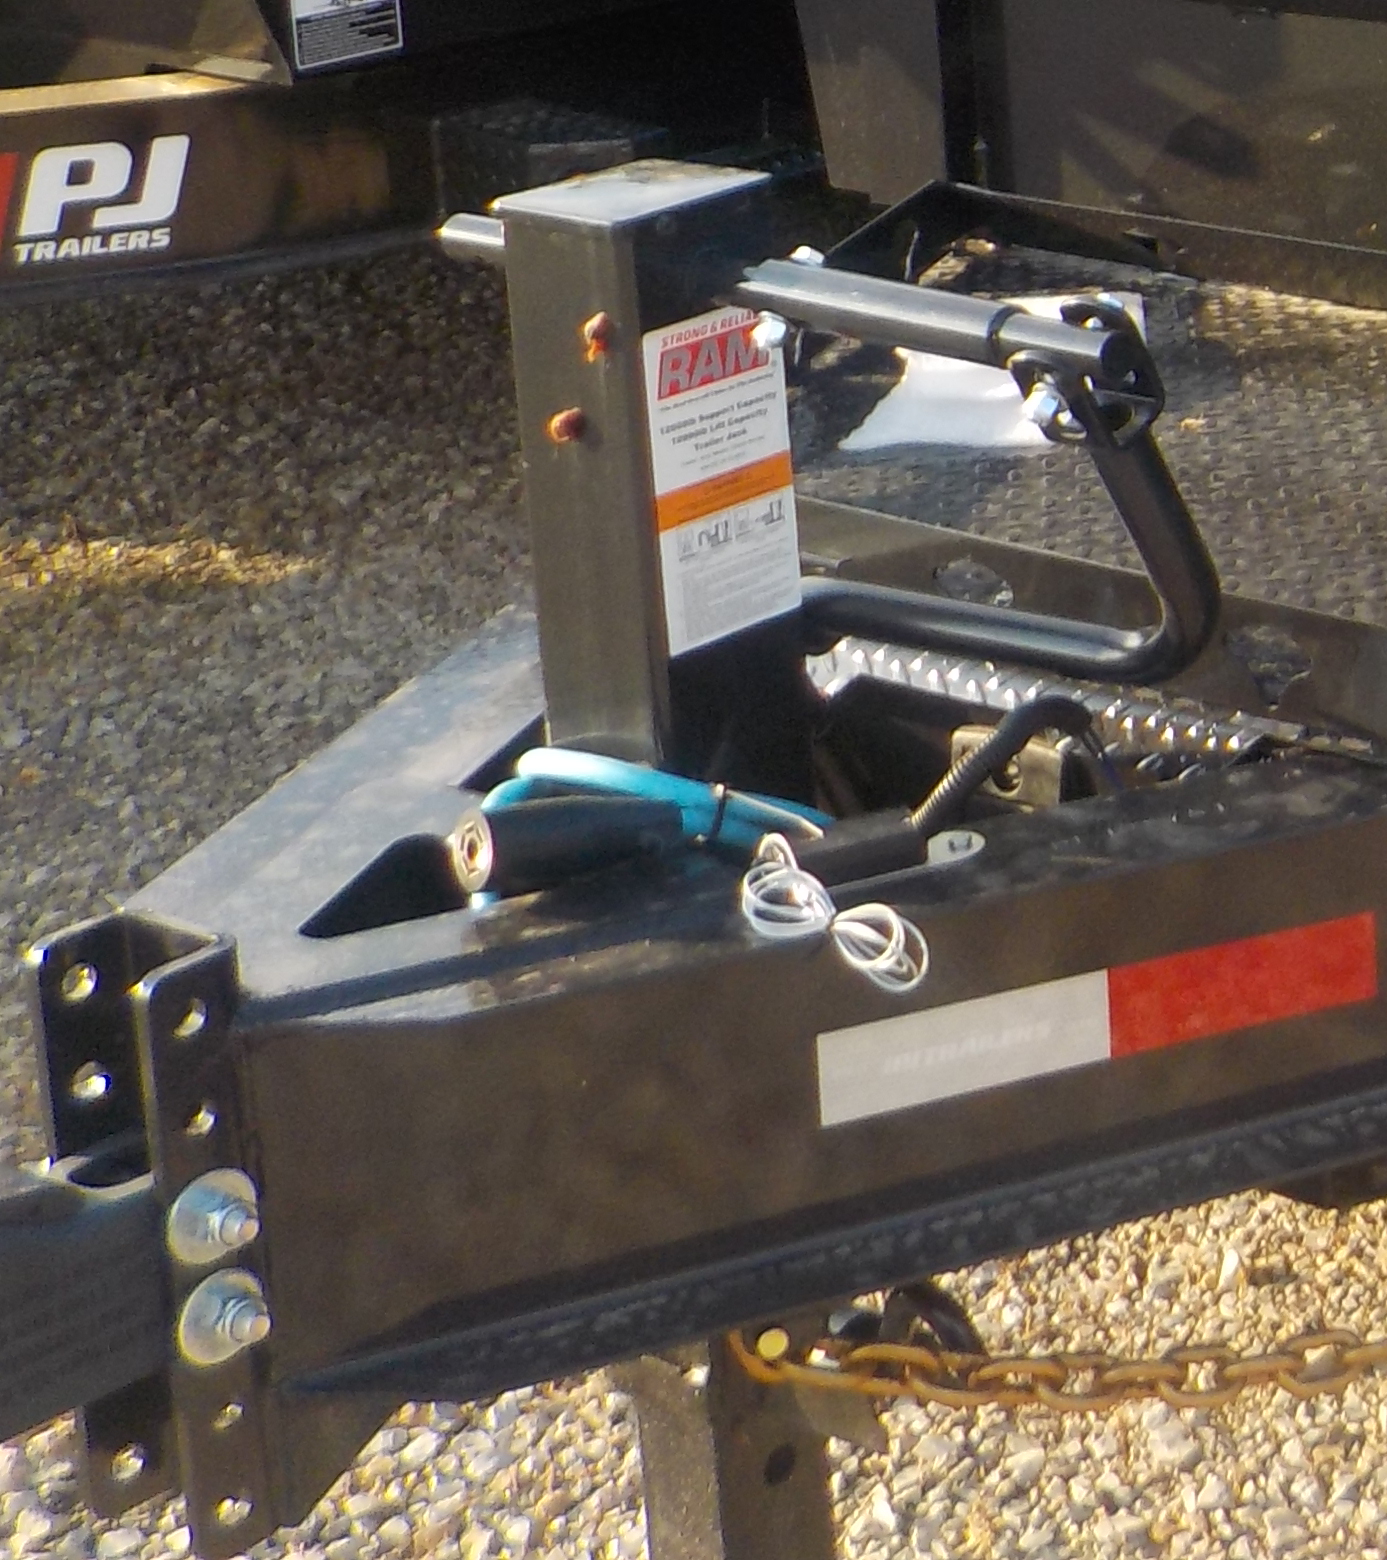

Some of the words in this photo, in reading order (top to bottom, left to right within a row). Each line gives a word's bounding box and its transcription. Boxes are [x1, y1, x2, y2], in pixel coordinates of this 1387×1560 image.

[18, 134, 191, 237] PJ
[13, 227, 172, 265] TRAILERS
[661, 324, 708, 348] STRONG
[720, 310, 759, 330] RELIA
[660, 328, 768, 399] RAM
